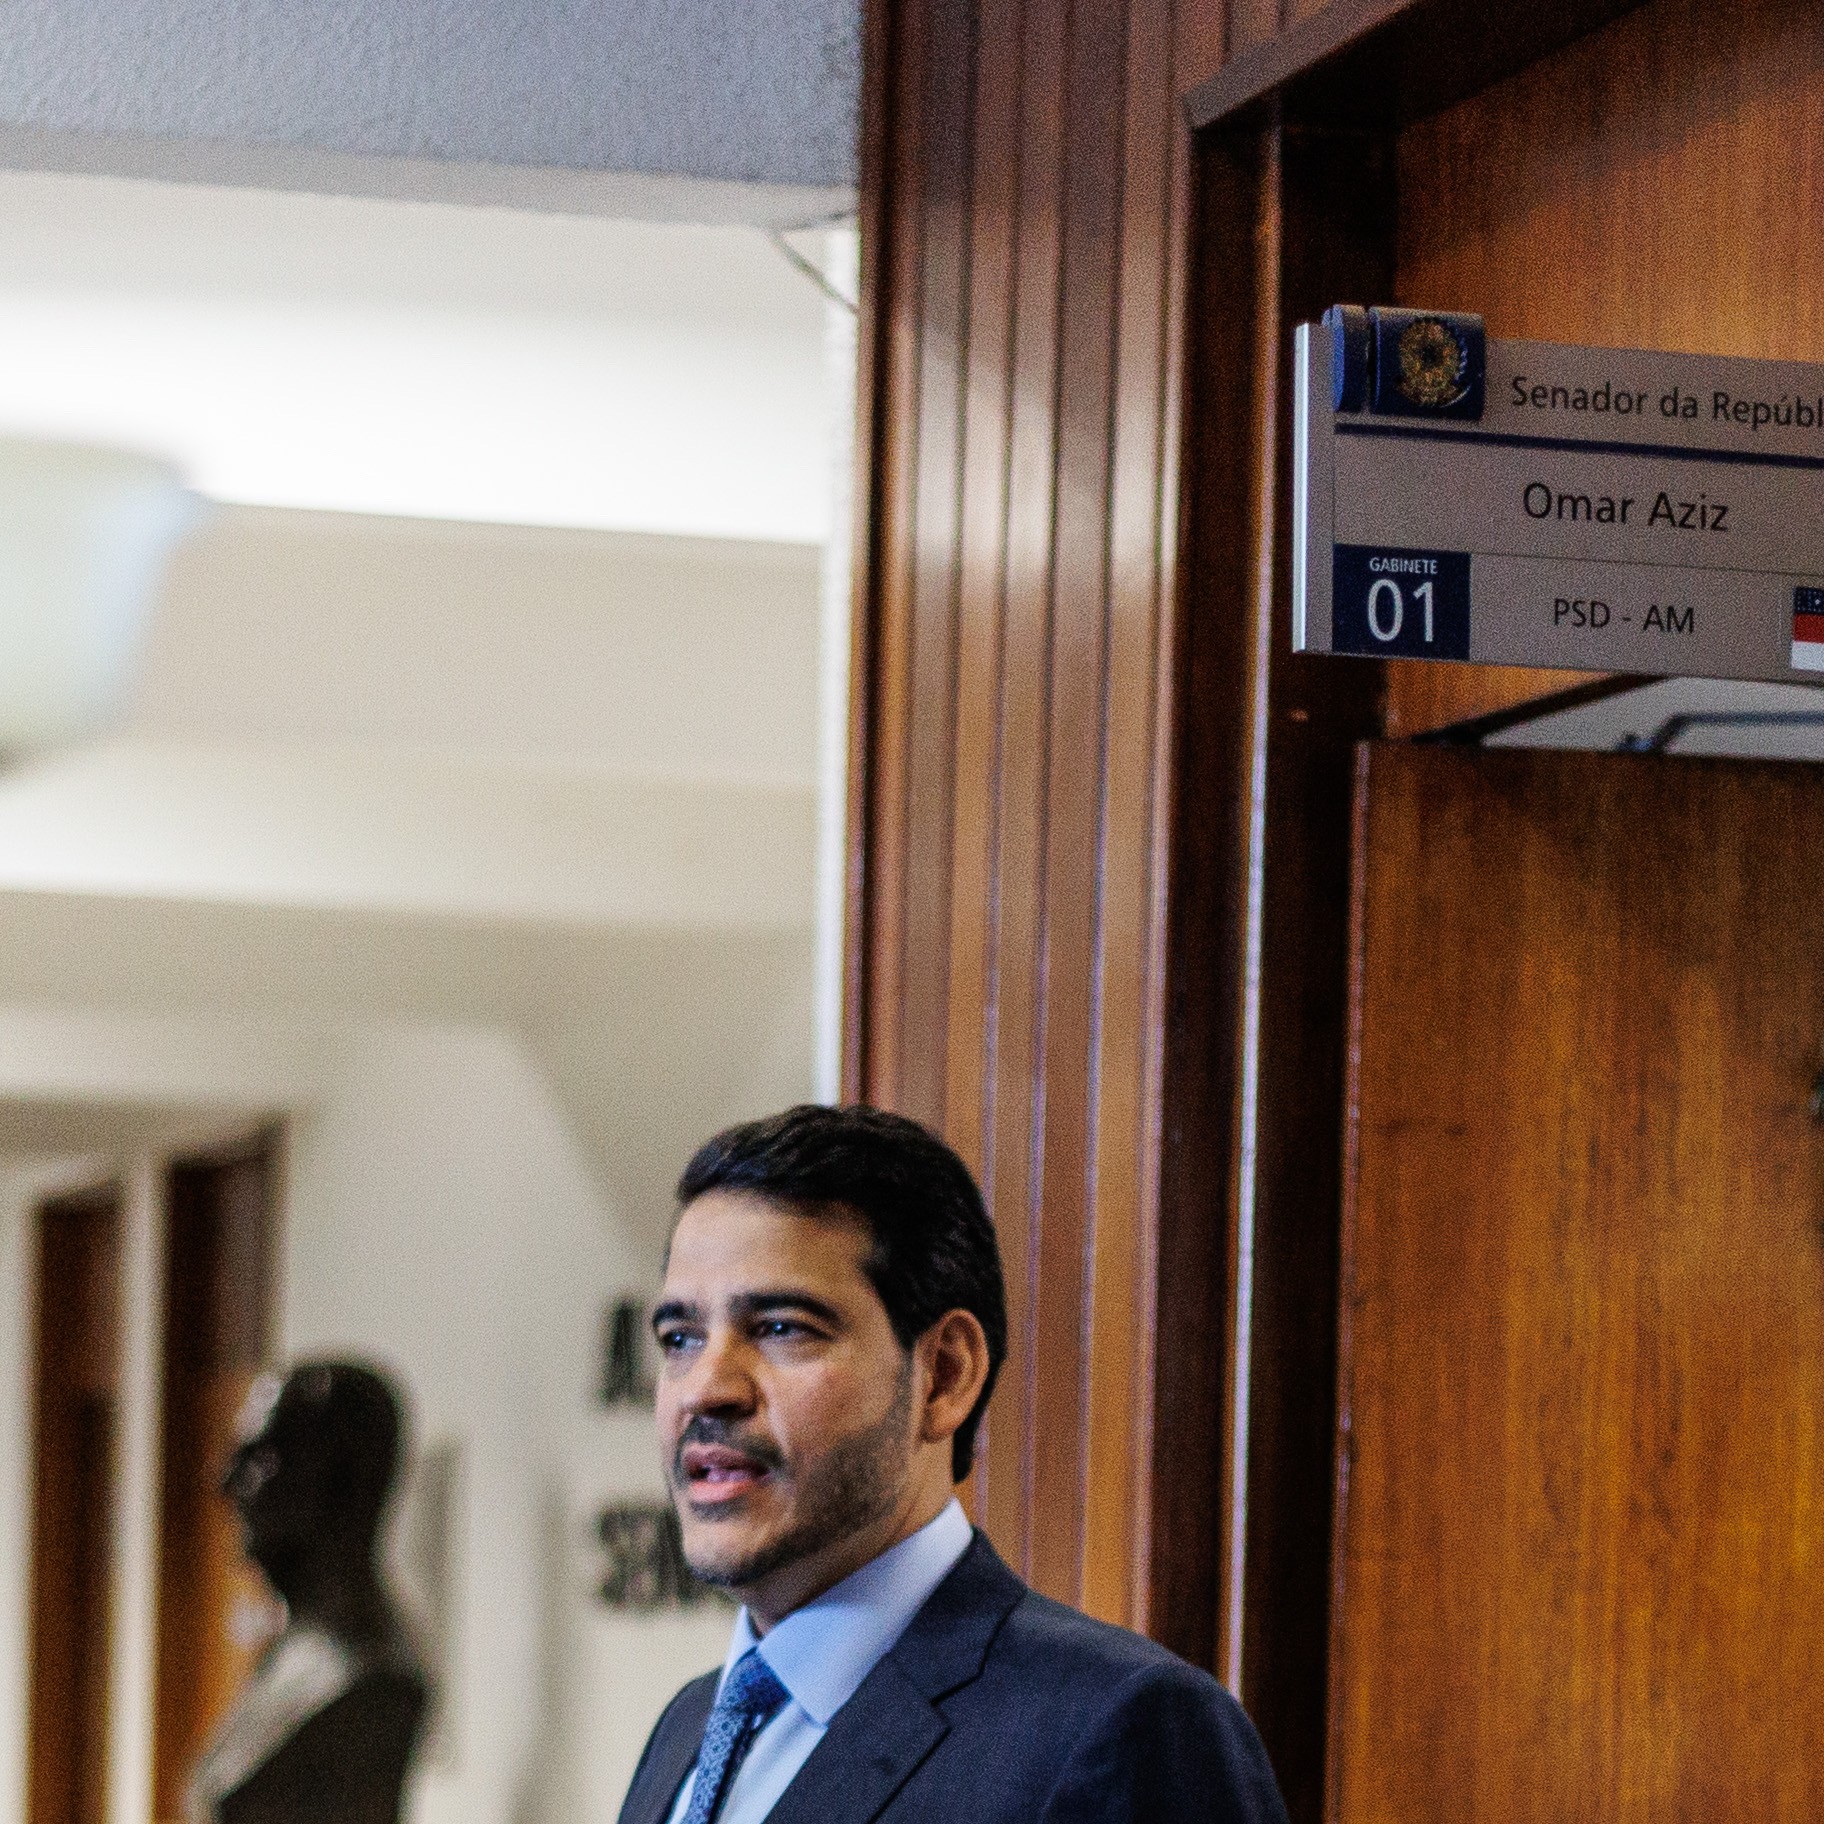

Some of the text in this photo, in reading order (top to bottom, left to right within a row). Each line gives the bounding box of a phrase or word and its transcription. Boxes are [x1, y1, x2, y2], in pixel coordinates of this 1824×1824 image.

[1511, 376, 1650, 417] Senador
[1659, 385, 1699, 419] da
[1522, 482, 1730, 532] Omar Aziz
[1369, 557, 1438, 576] GABINETE
[1367, 579, 1434, 643] 01
[1553, 599, 1611, 629] PSD
[1643, 604, 1696, 634] AM
